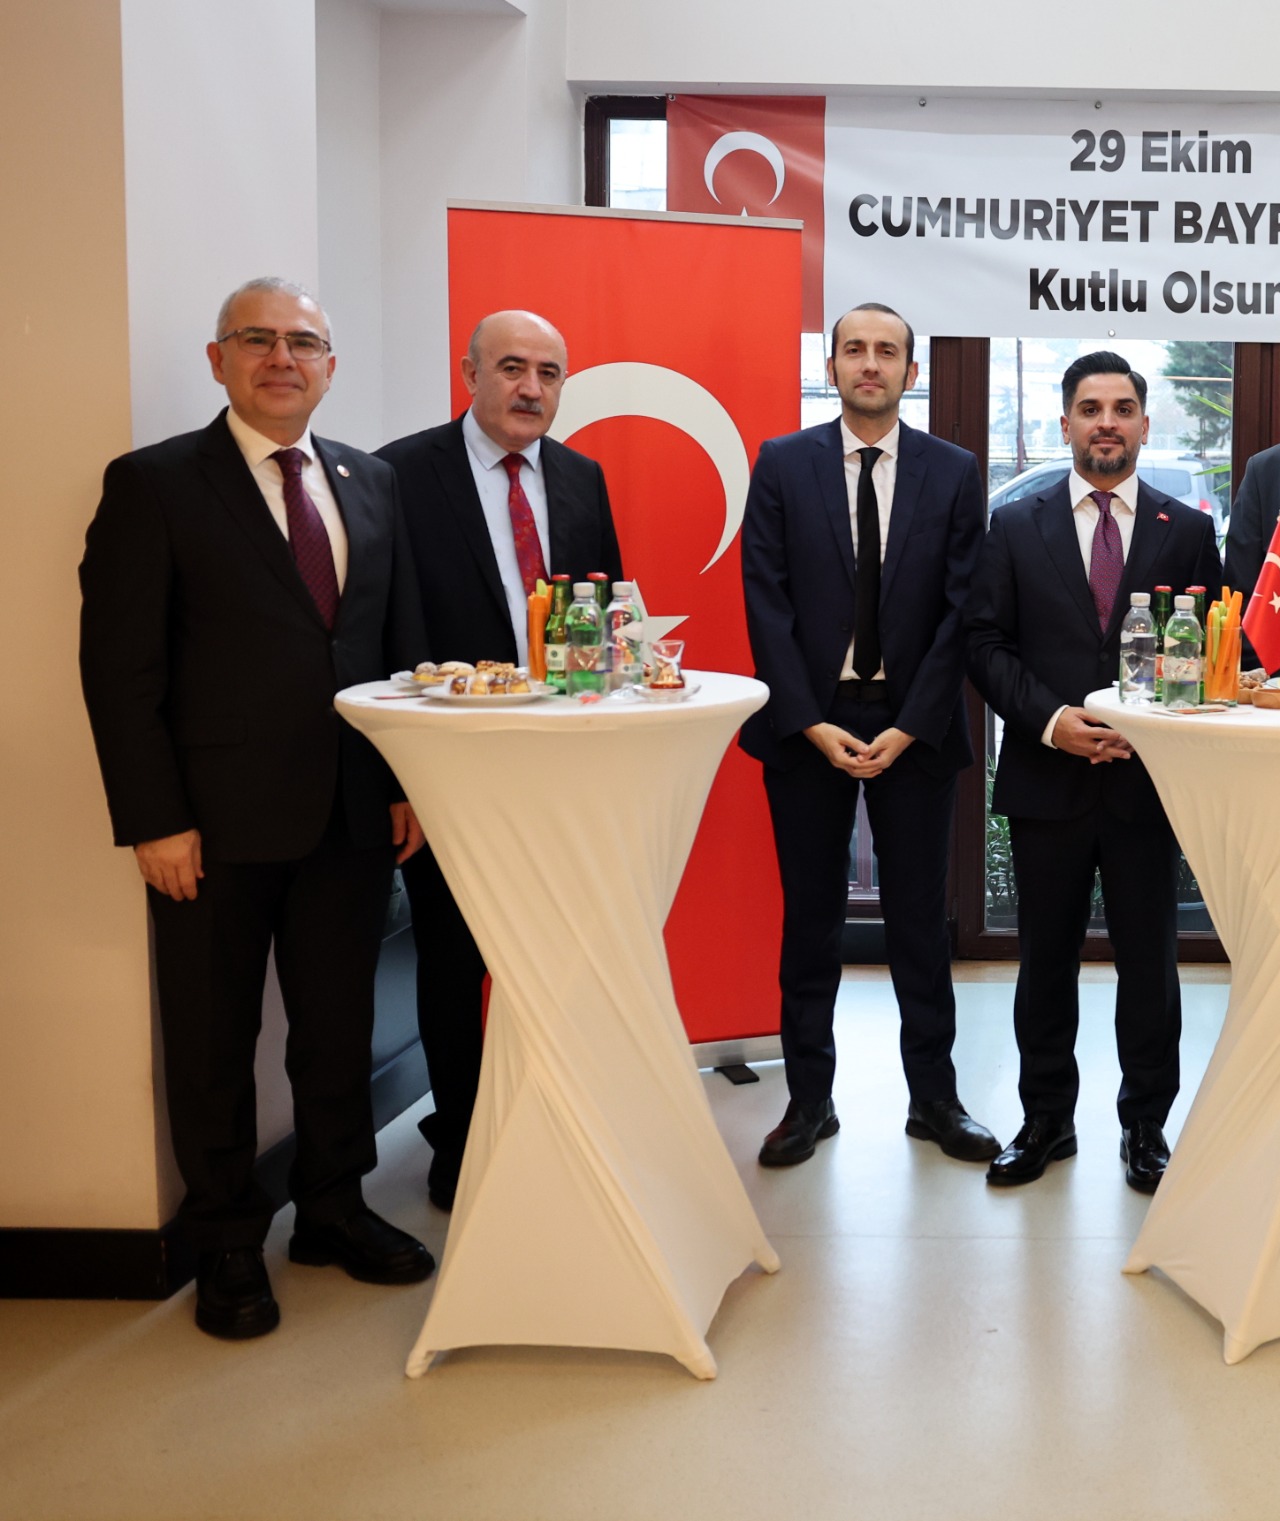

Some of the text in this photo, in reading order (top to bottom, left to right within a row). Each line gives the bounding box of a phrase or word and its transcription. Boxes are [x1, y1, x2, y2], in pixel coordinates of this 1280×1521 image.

[1070, 128, 1252, 174] 29 Ekim
[1029, 267, 1147, 313] Kutlu
